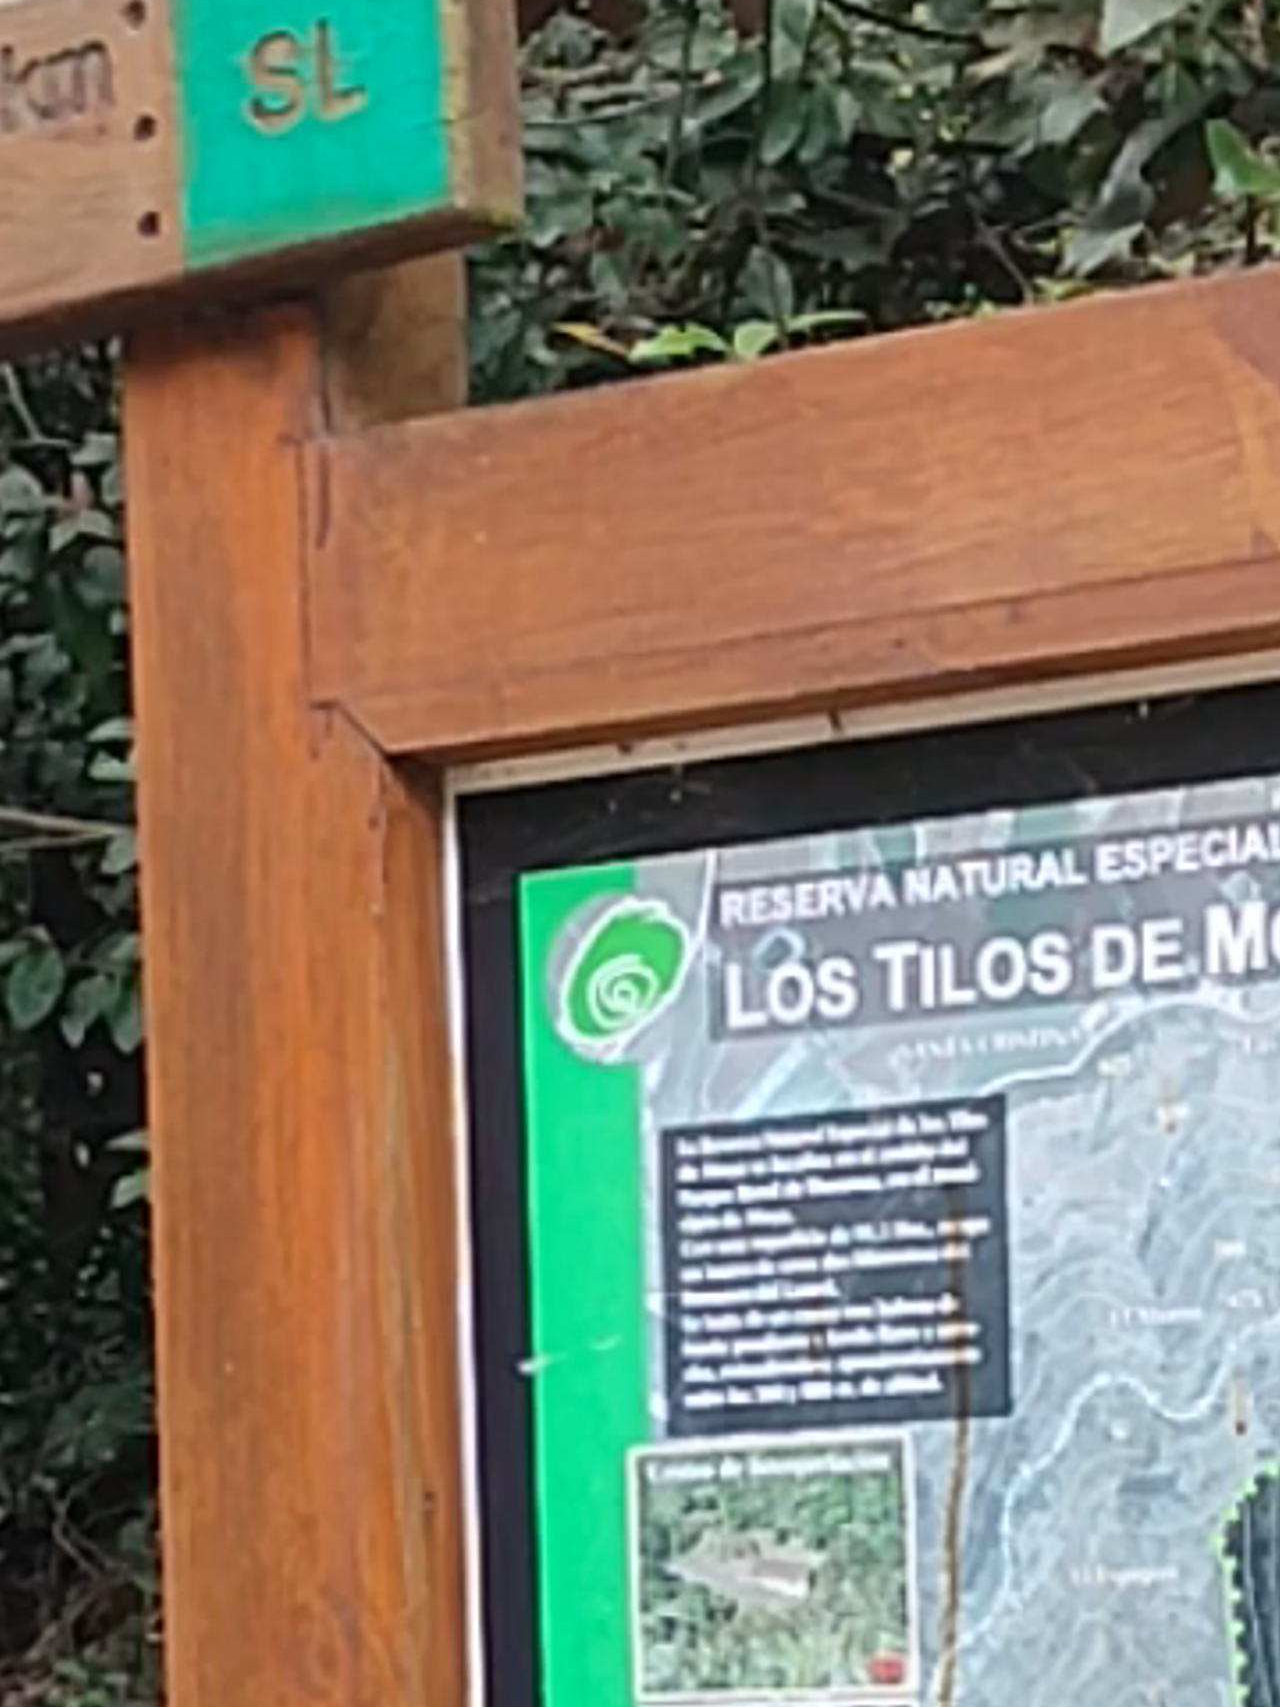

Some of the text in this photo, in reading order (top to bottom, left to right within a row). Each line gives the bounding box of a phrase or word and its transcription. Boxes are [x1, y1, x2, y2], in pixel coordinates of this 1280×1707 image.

[243, 15, 367, 135] SL
[721, 871, 897, 930] RESERVA
[903, 849, 1088, 906] NATURAL
[724, 956, 859, 1030] LOS
[874, 932, 1072, 1012] TILOS
[1091, 918, 1184, 989] DE
